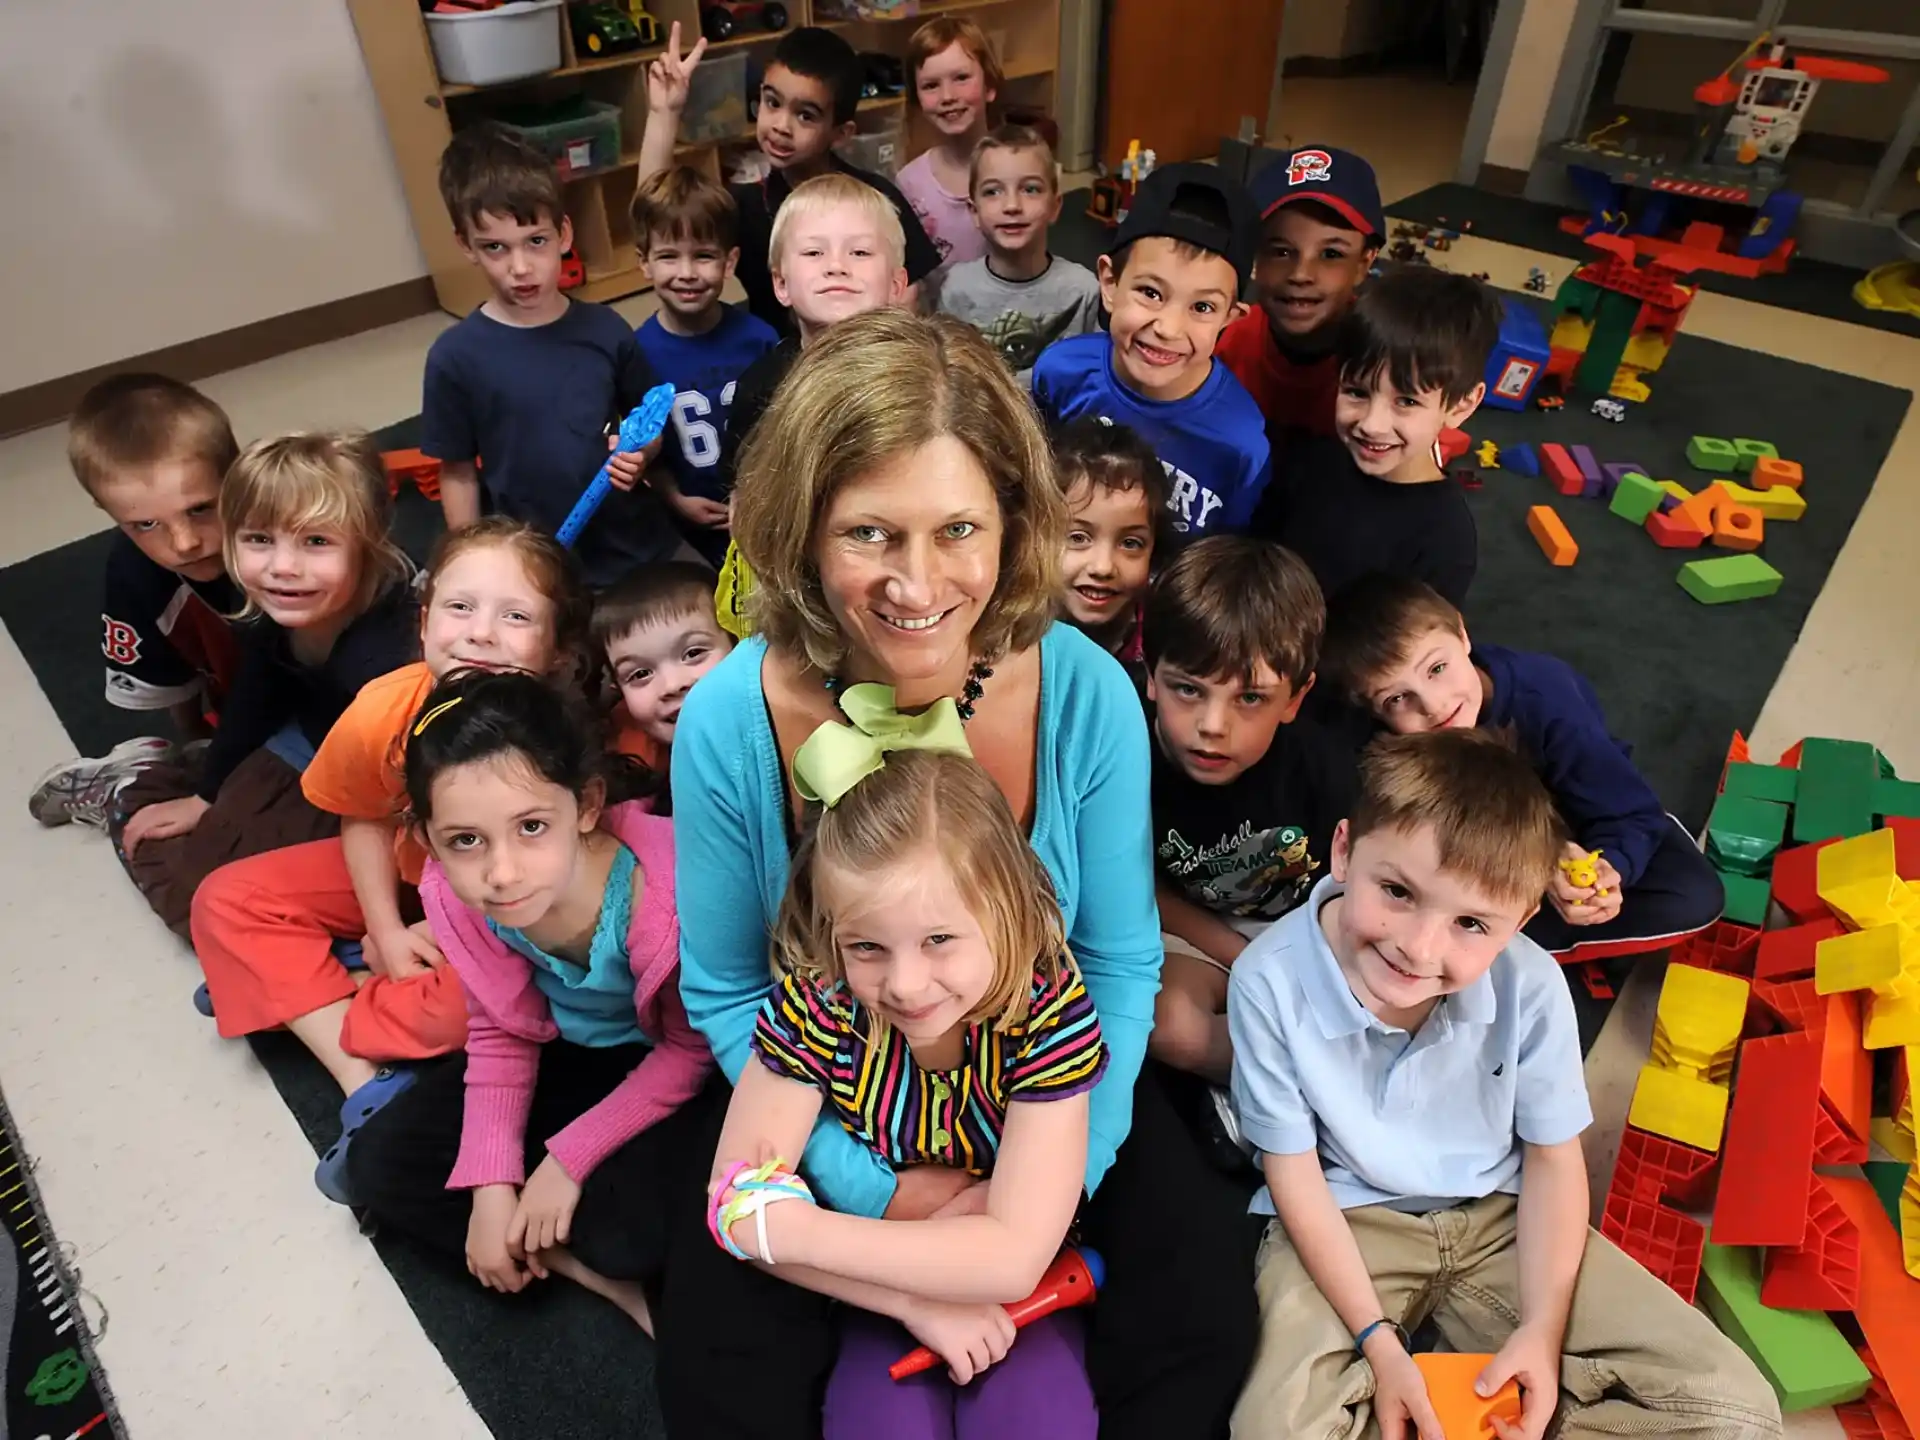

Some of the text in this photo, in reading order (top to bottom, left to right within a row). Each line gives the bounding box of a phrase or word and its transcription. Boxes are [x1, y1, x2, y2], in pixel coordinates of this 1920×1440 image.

[1289, 150, 1332, 186] P
[671, 381, 737, 468] 6
[101, 613, 143, 665] B
[1168, 819, 1254, 877] Basketball
[1203, 851, 1266, 876] TEAM
